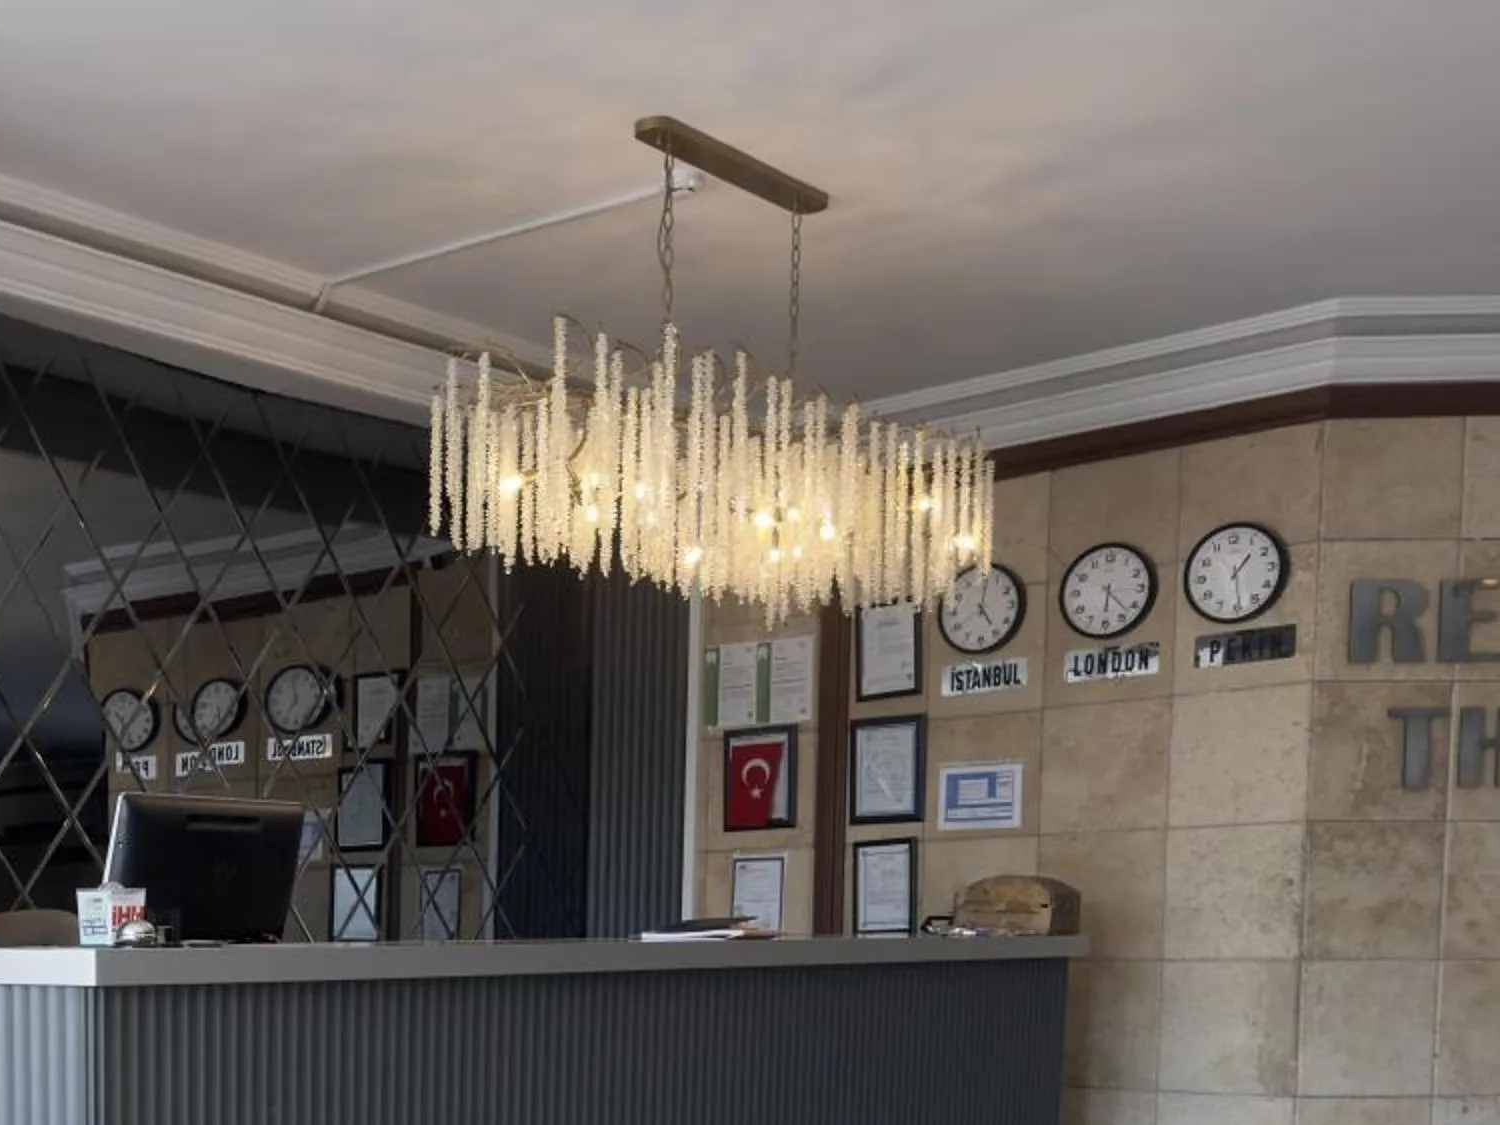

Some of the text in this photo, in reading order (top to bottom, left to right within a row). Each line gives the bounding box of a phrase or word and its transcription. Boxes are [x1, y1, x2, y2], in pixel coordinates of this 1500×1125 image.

[1348, 579, 1500, 663] RE
[950, 662, 1021, 692] İSTANBUL
[1073, 648, 1149, 677] LONDON
[1387, 707, 1500, 790] TH
